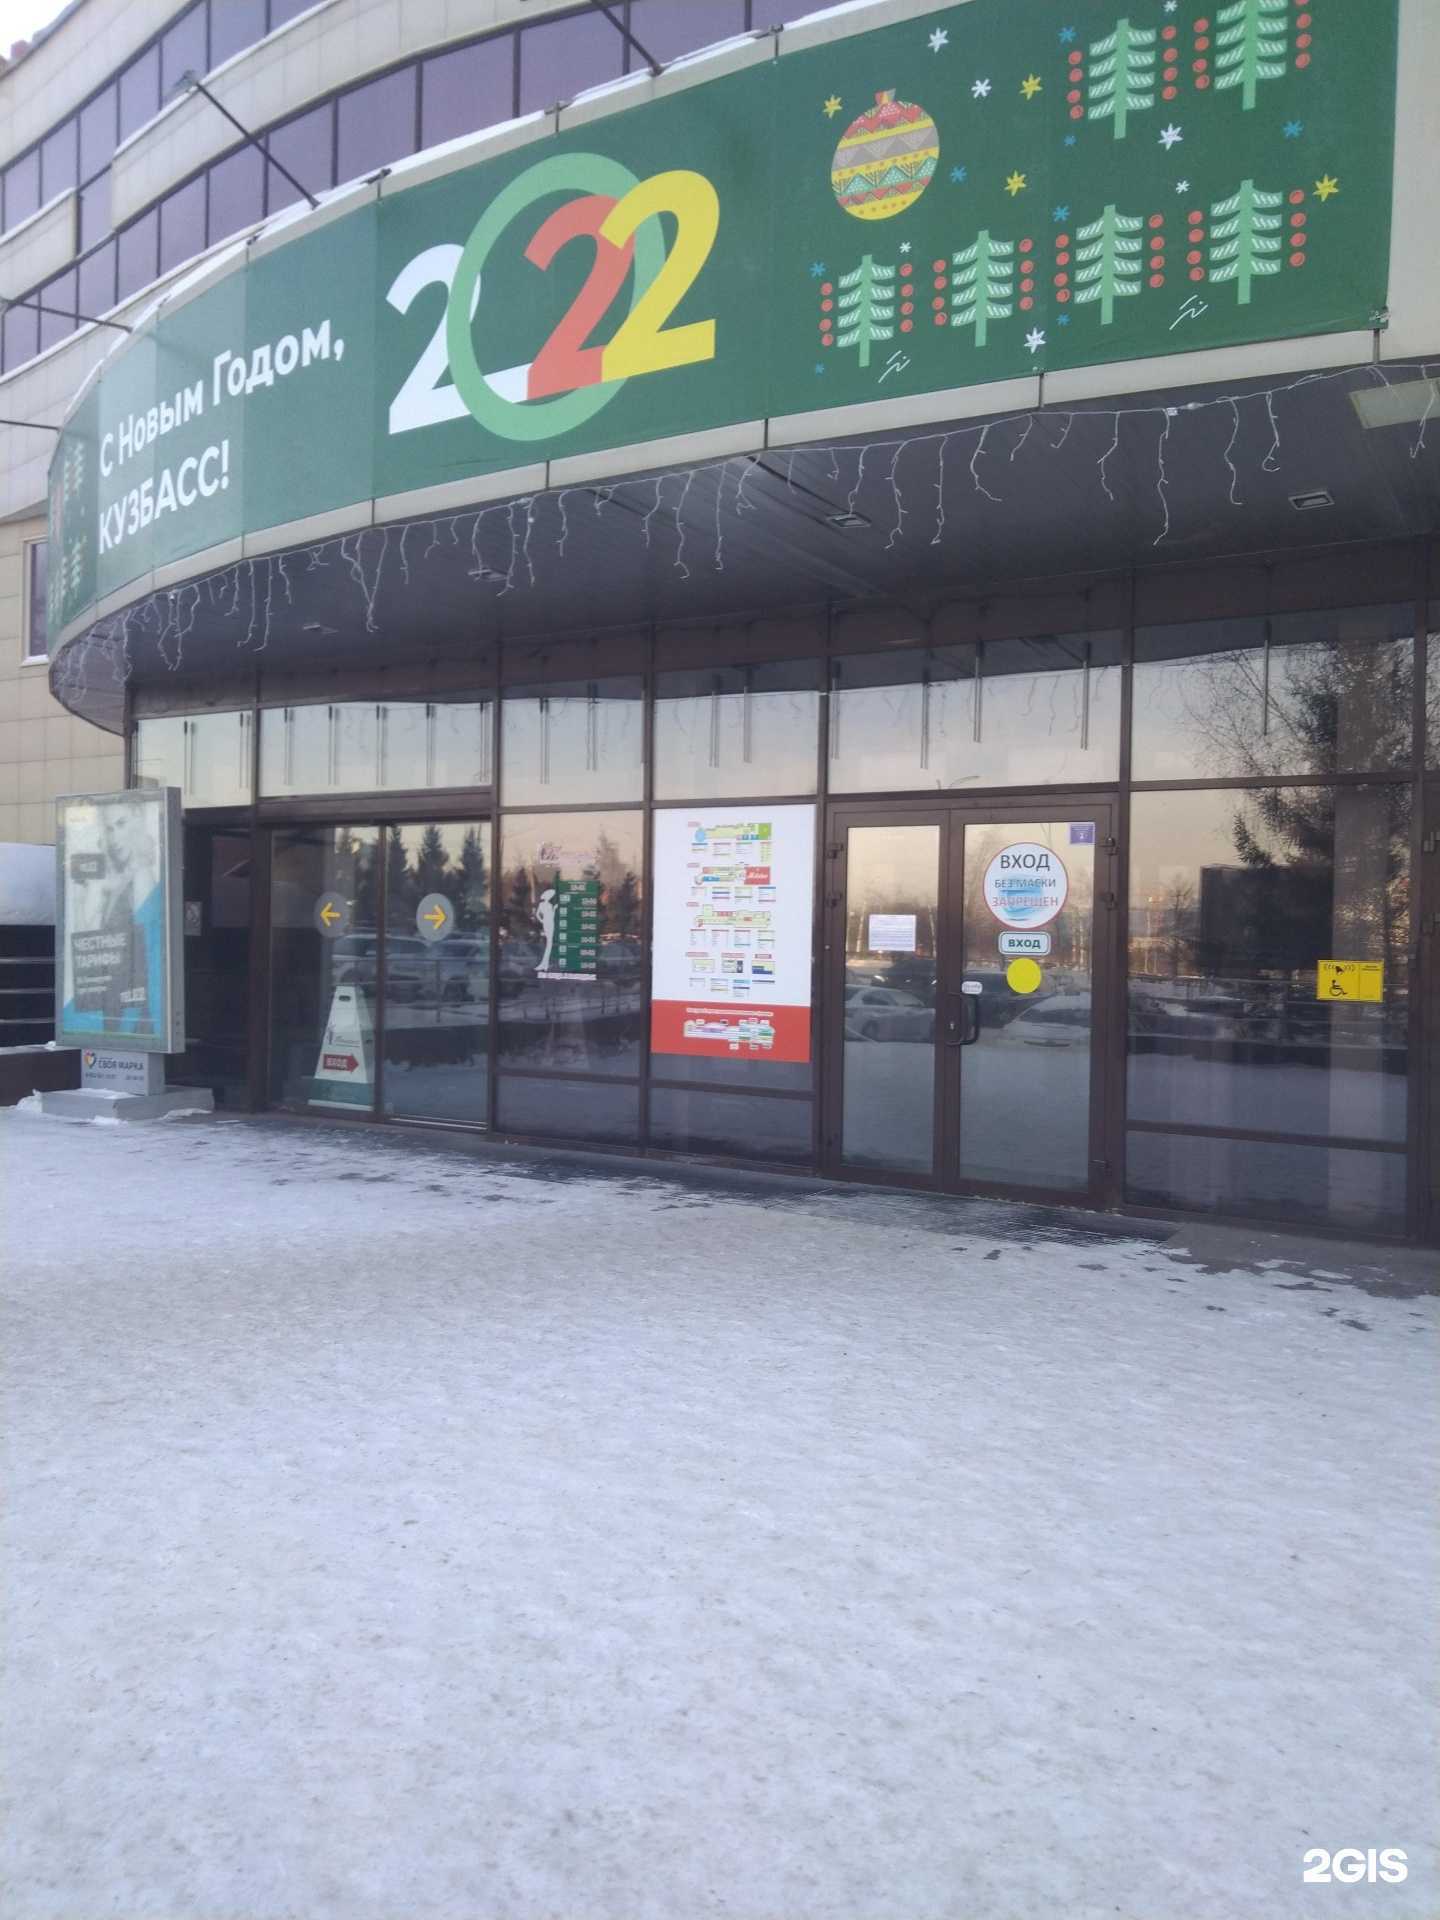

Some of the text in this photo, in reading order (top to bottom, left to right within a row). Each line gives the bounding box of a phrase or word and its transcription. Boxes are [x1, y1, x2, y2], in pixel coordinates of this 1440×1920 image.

[386, 152, 720, 442] 2022
[100, 319, 345, 478] С Новым Годом,
[98, 439, 231, 555] КУЗБАСС!
[1000, 854, 1050, 871] ВХОД
[994, 878, 1056, 889] БЕЗ МАСКИ
[992, 896, 1058, 908] ЗАПРЕЩЕН
[1008, 938, 1041, 950] ВХОД
